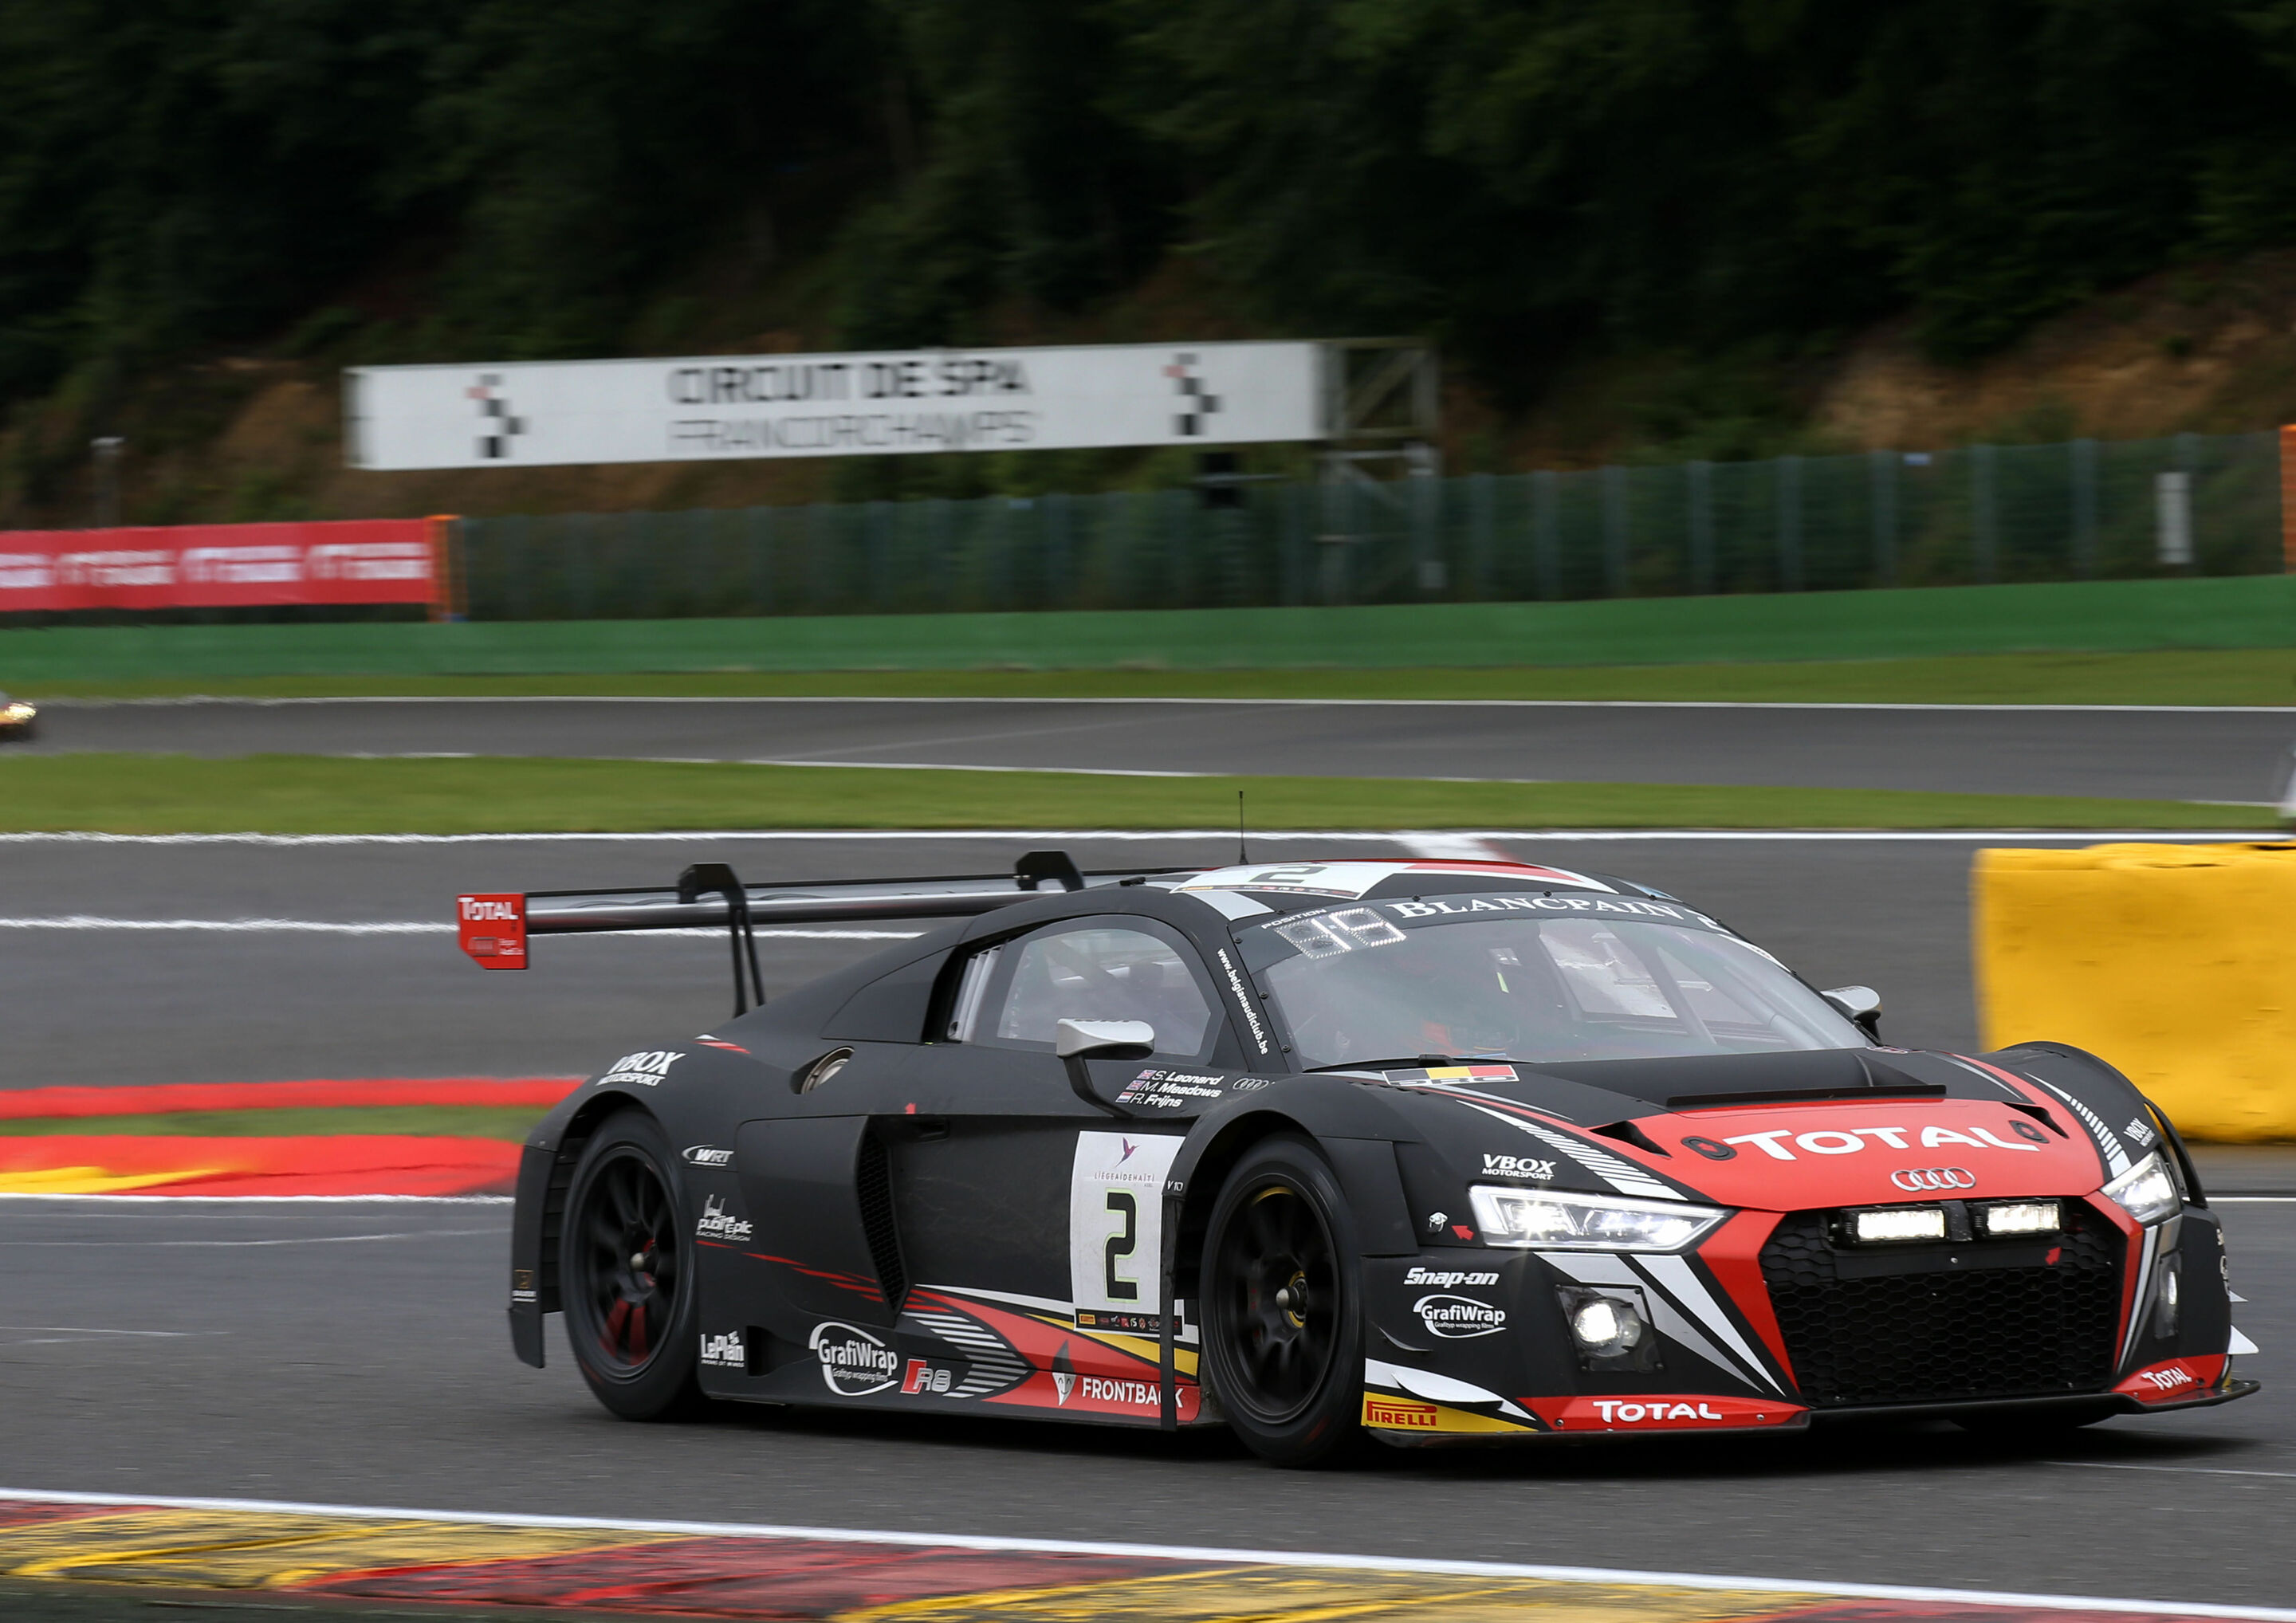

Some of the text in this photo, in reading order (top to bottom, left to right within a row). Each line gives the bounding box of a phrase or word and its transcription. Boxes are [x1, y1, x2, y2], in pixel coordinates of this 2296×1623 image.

[934, 358, 1032, 396] SPA
[1248, 866, 1328, 883] 2
[458, 897, 519, 921] TOTAL
[1261, 908, 1327, 929] POSITION
[1385, 897, 1685, 921] BLANCPAIN
[1217, 948, 1268, 1055] www.belgianaudiclub.be
[606, 1051, 687, 1075] VBOX
[1140, 1081, 1222, 1098] M. Meadows
[1151, 1071, 1225, 1086] S. Leonard
[1130, 1093, 1183, 1108] R. Frijns
[2123, 1117, 2150, 1142] VBOX
[1724, 1126, 2041, 1161] TOTAL
[694, 1149, 734, 1163] WRT
[1483, 1153, 1556, 1174] VBOX
[1482, 1168, 1555, 1181] MOTORSPORT
[1167, 1180, 1184, 1193] V10
[1105, 1190, 1138, 1302] 2
[1403, 1267, 1500, 1288] Snap-on
[1421, 1304, 1506, 1326] GrafiWrap
[818, 1338, 898, 1376] GrafiWrap
[2141, 1366, 2192, 1390] TOTAL
[1082, 1377, 1184, 1409] FRONTBAK
[1366, 1401, 1438, 1426] PIRELLI
[1592, 1400, 1723, 1423] TOTAL
